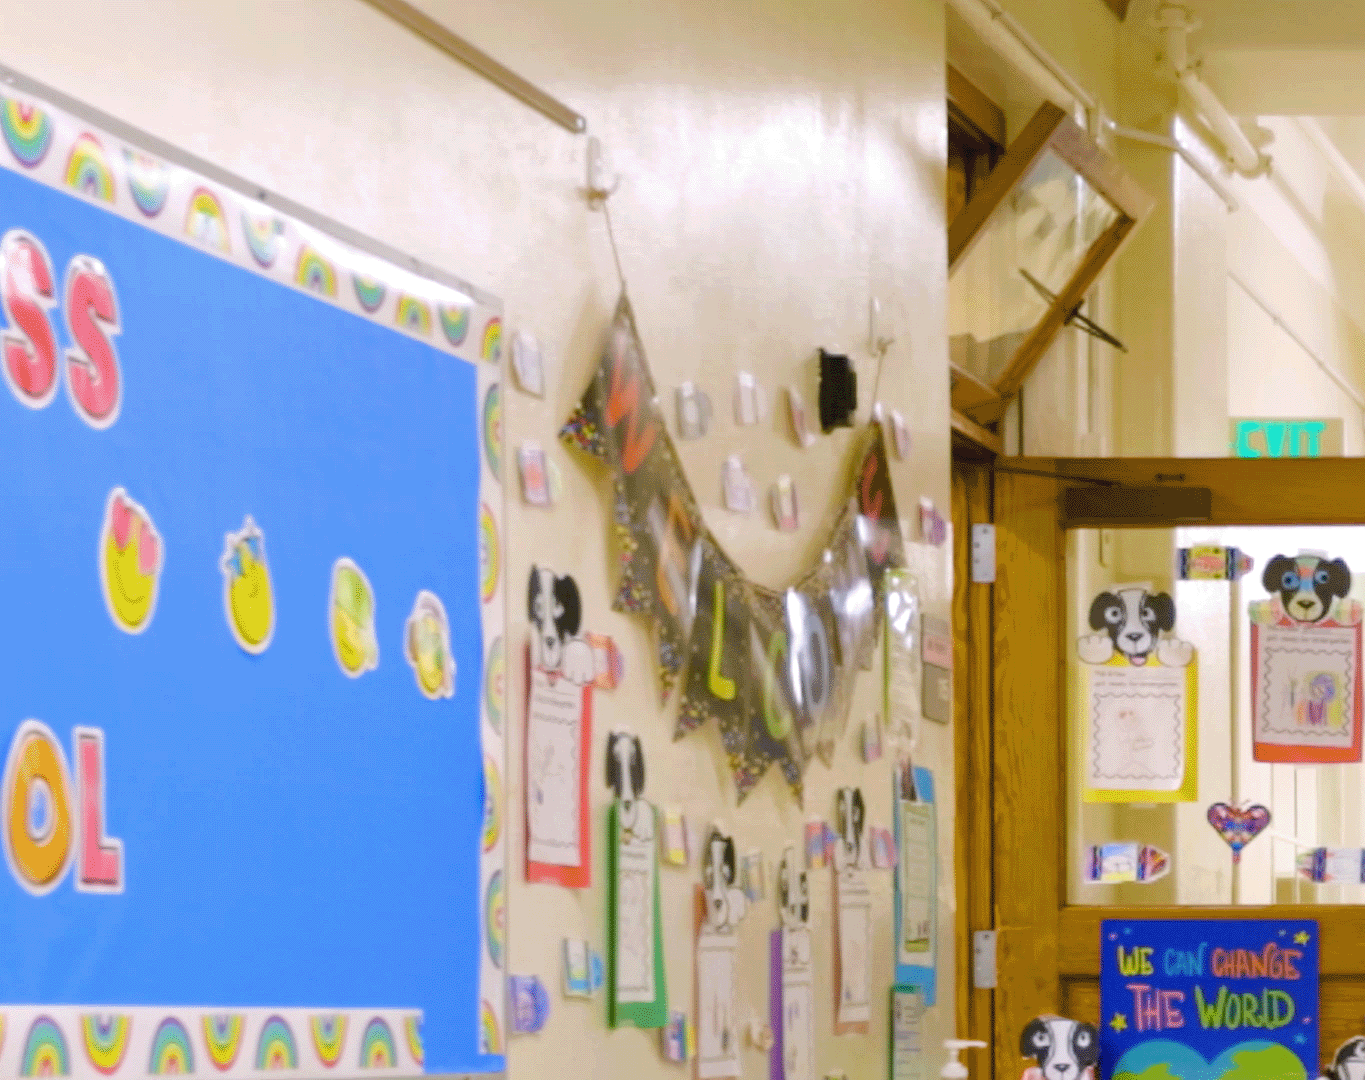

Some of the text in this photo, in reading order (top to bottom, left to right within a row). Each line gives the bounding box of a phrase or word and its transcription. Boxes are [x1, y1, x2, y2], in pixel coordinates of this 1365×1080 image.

[1116, 941, 1303, 980] WE CAN CHANGE
[1125, 982, 1297, 1033] THE WORLD
